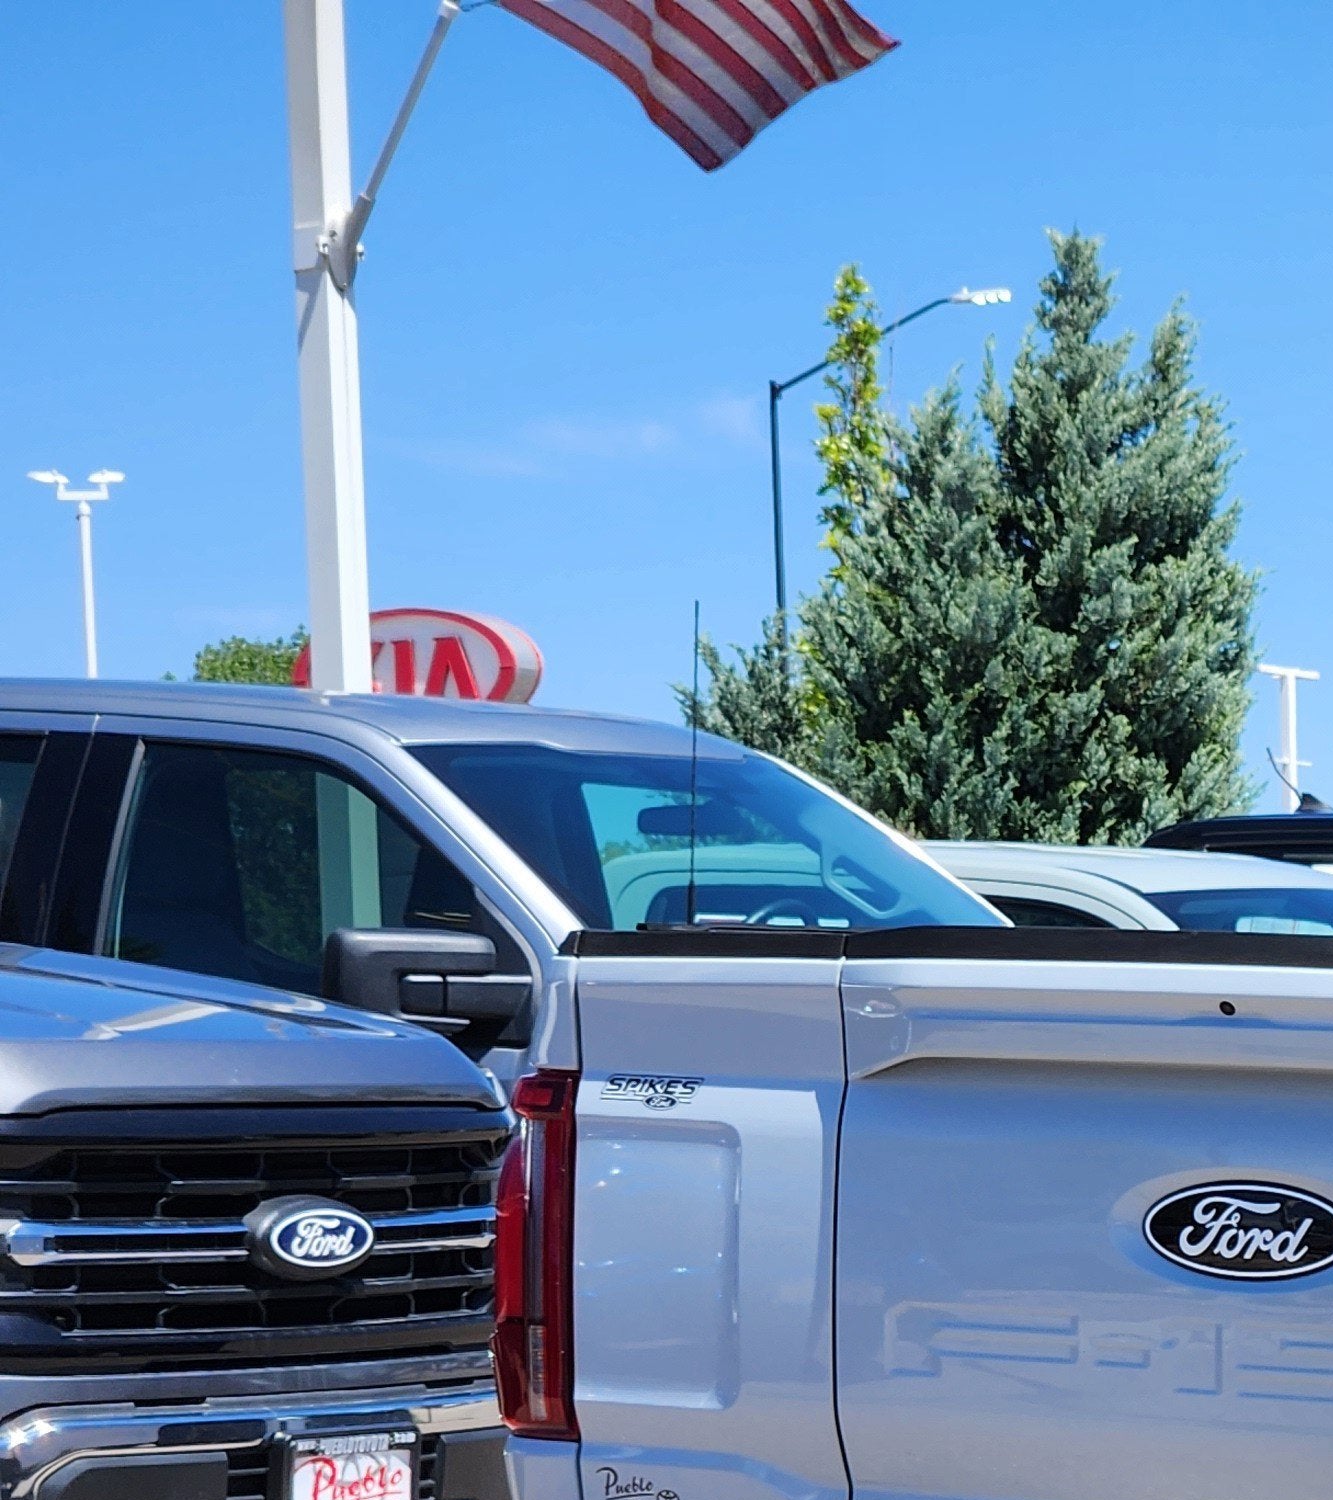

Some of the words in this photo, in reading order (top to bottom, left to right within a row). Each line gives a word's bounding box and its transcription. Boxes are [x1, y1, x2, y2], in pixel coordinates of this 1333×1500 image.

[371, 636, 479, 699] IA
[605, 1077, 702, 1095] SPIKES
[291, 1217, 356, 1257] Ford
[1179, 1196, 1314, 1262] Ford
[595, 1466, 654, 1497] Pueblo
